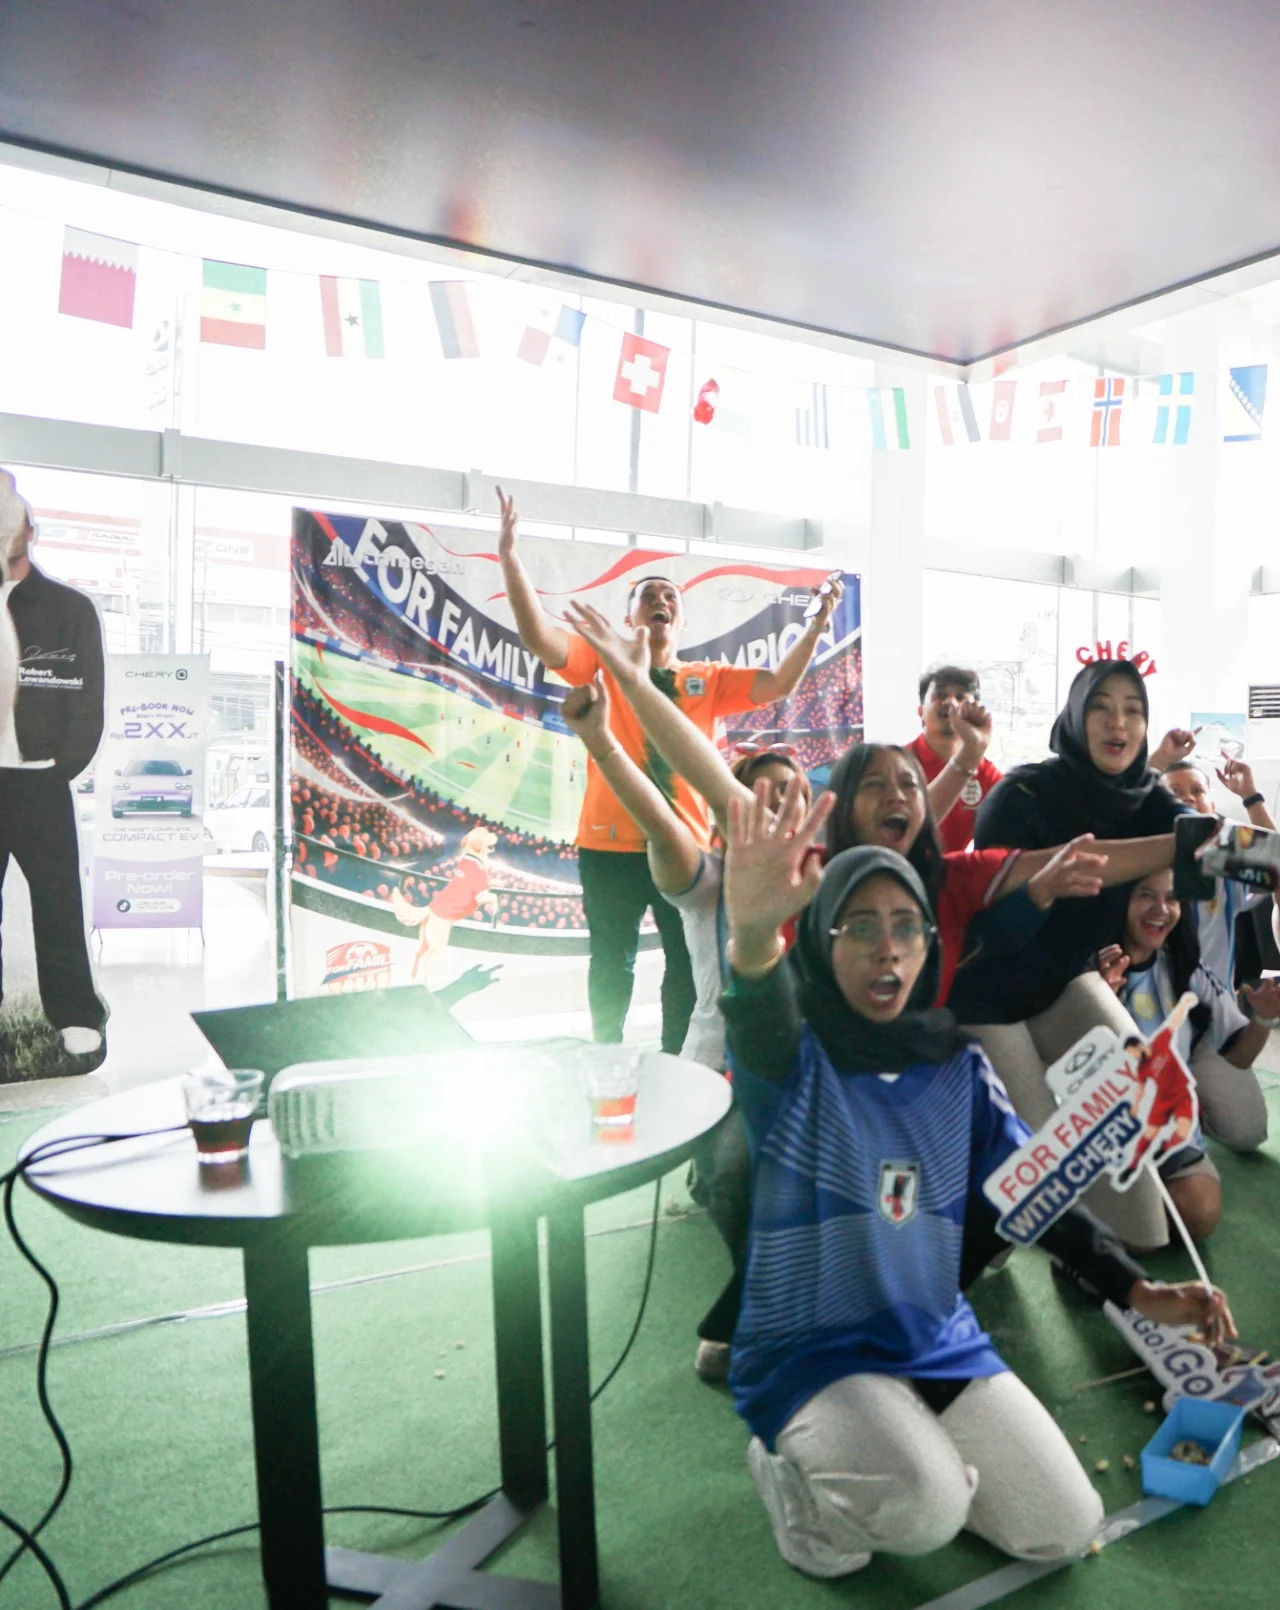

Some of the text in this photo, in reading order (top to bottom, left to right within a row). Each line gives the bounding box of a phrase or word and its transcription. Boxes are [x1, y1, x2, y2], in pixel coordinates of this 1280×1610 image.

[351, 517, 435, 634] FOR
[437, 599, 541, 690] FAMILY
[19, 667, 53, 676] Robert
[102, 833, 199, 842] COMPACT EV
[104, 869, 195, 881] Pre-order
[126, 882, 173, 894] Now!
[998, 1061, 1140, 1202] FOR FAMILY
[1007, 1110, 1136, 1239] WITH CHERY
